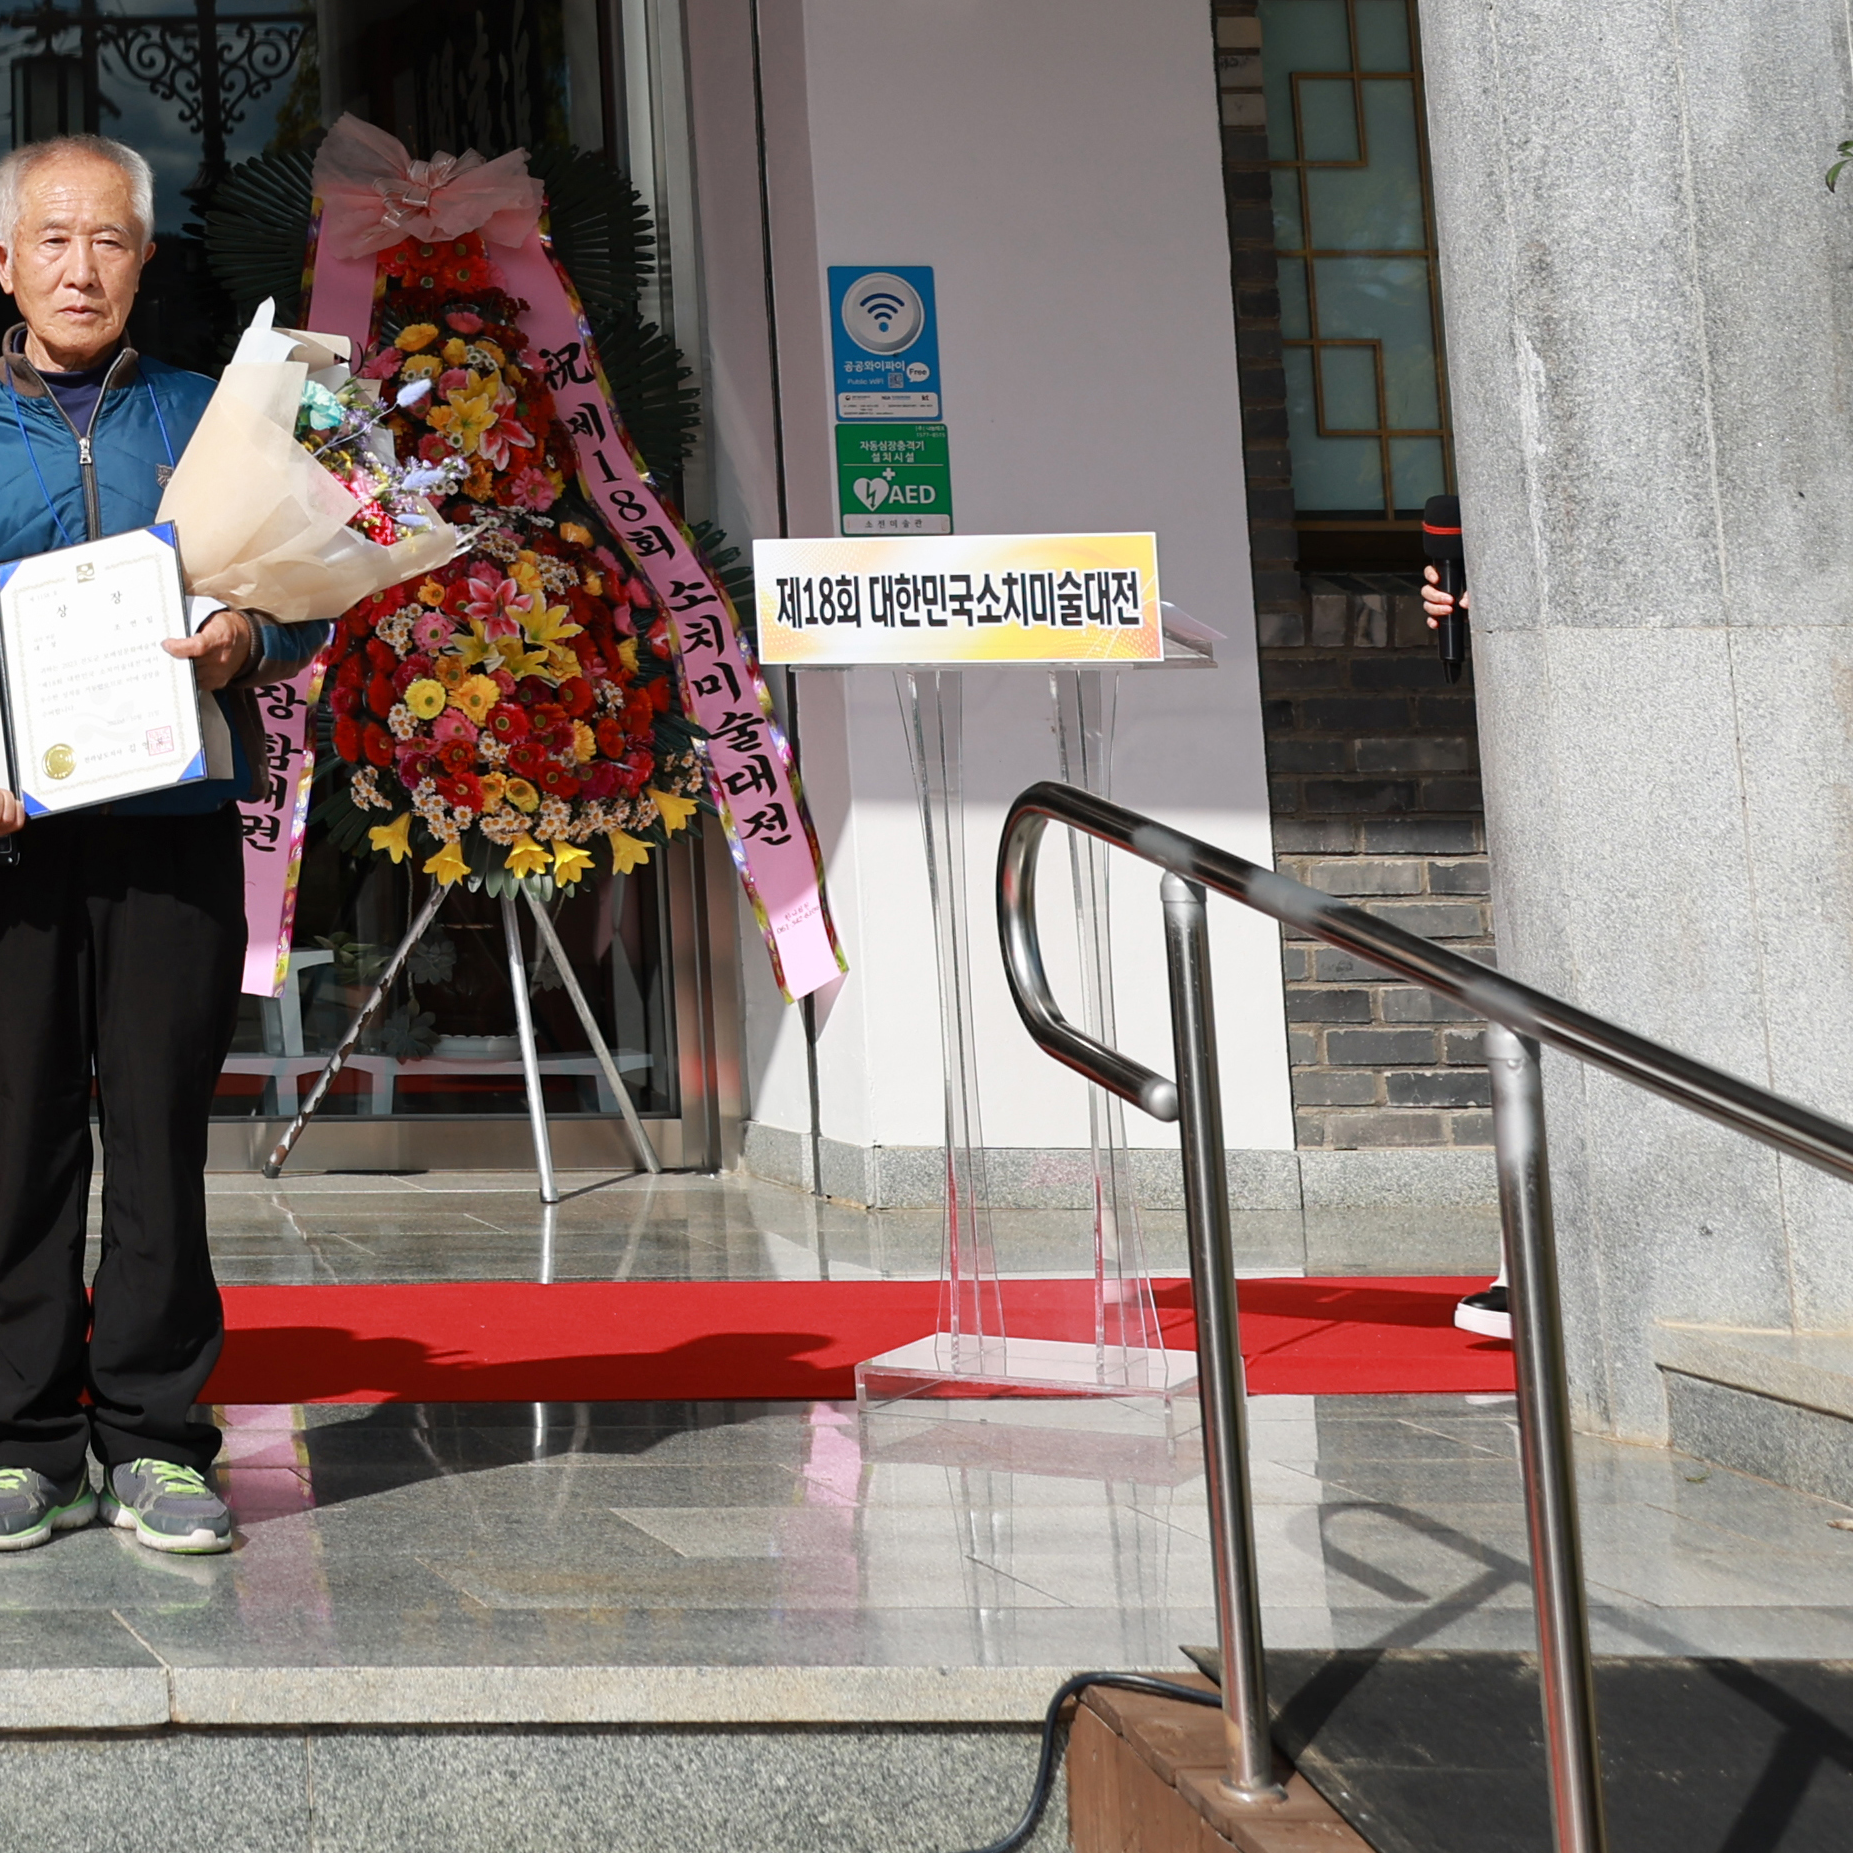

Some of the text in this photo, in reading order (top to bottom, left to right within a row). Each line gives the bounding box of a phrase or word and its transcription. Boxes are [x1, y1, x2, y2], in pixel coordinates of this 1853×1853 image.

[843, 359, 906, 373] 공공와이파이
[908, 367, 928, 376] Free
[859, 439, 925, 452] 자동심장충격기
[888, 484, 936, 505] AED
[776, 571, 1141, 629] 제18회 대한민국소치미술대전
[667, 578, 793, 846] 소치미술대전
